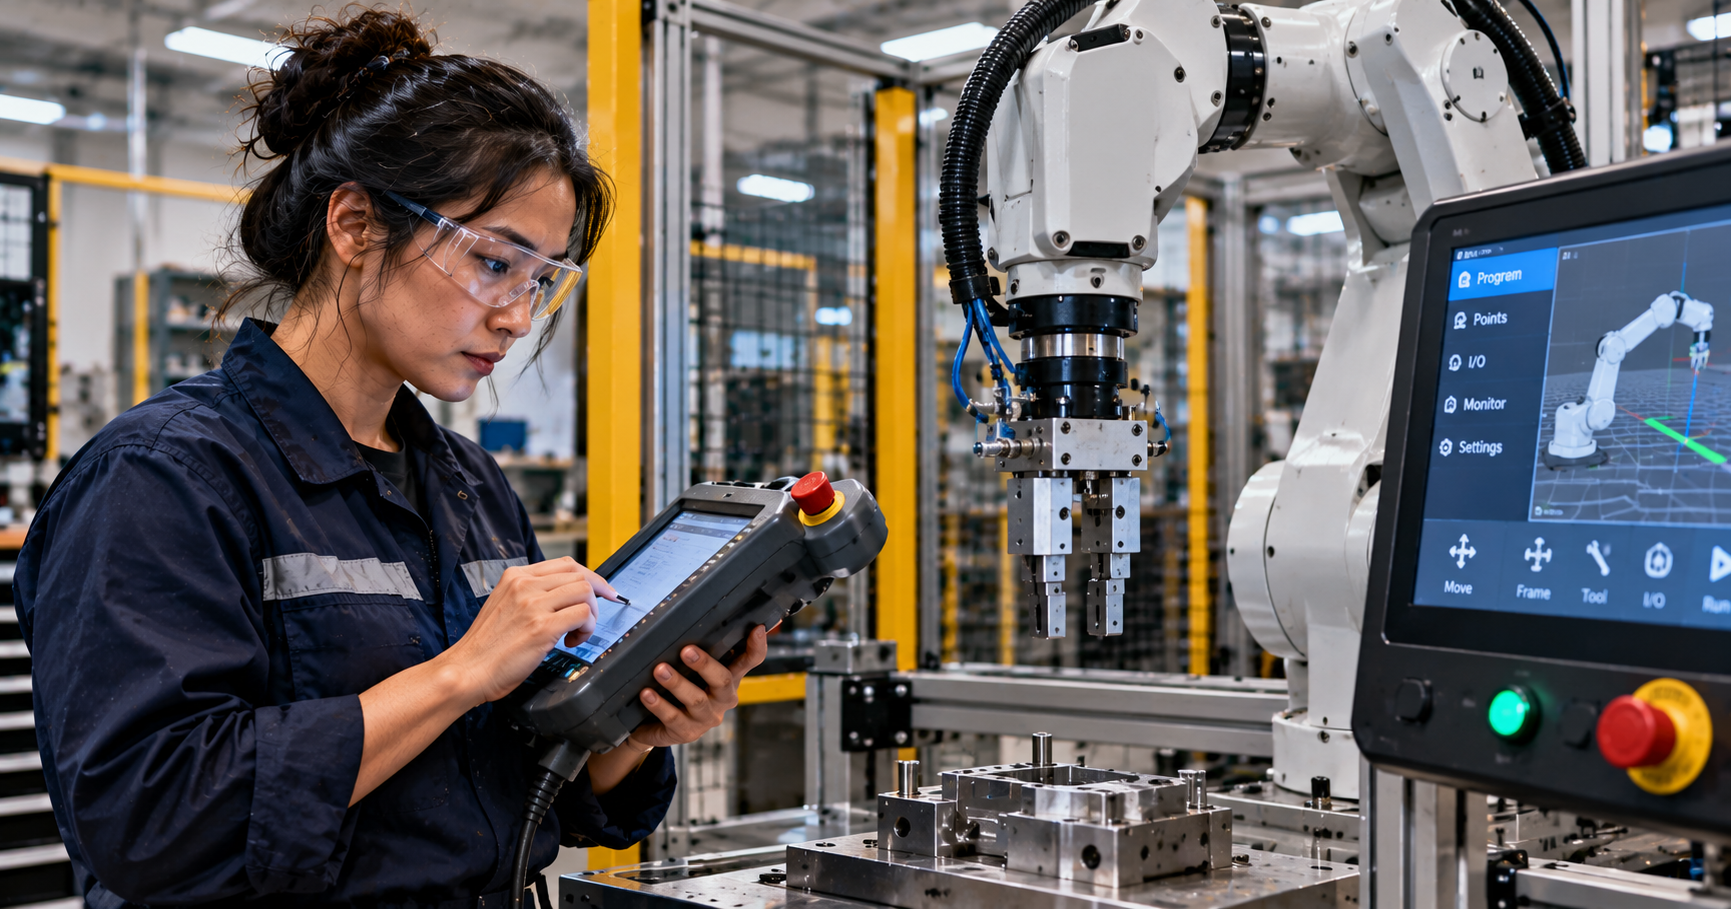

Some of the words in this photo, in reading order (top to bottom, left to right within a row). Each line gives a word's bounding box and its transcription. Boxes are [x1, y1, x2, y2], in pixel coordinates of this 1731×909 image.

[1473, 311, 1508, 326] Points
[1468, 354, 1486, 369] I/O
[1463, 396, 1507, 411] Monitor
[1459, 440, 1503, 457] Settings
[1444, 580, 1473, 594] Move
[1516, 584, 1551, 600] Frame
[1581, 588, 1608, 604] Tool
[1643, 591, 1666, 609] I/O
